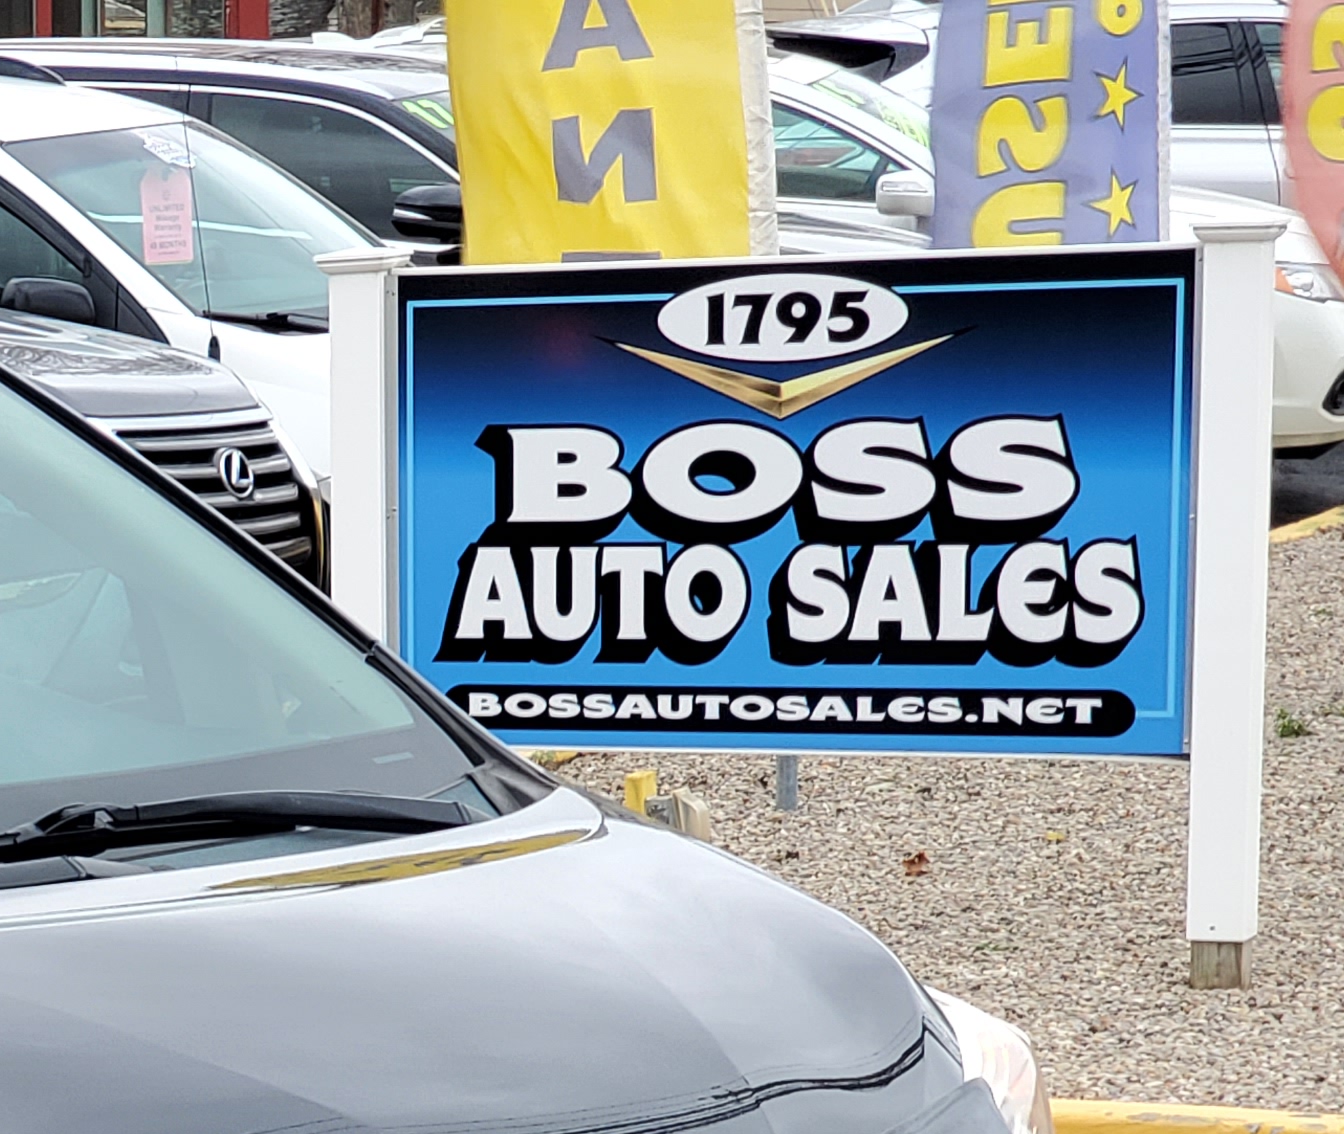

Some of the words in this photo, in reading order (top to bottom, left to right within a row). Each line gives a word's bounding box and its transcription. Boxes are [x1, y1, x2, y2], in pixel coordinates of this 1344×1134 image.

[704, 289, 871, 346] 1795
[502, 416, 1080, 526] BOSS
[453, 541, 750, 644] AUTO
[784, 538, 1142, 645] SALES
[466, 691, 1104, 726] BOSSAUTOSALES.NET
